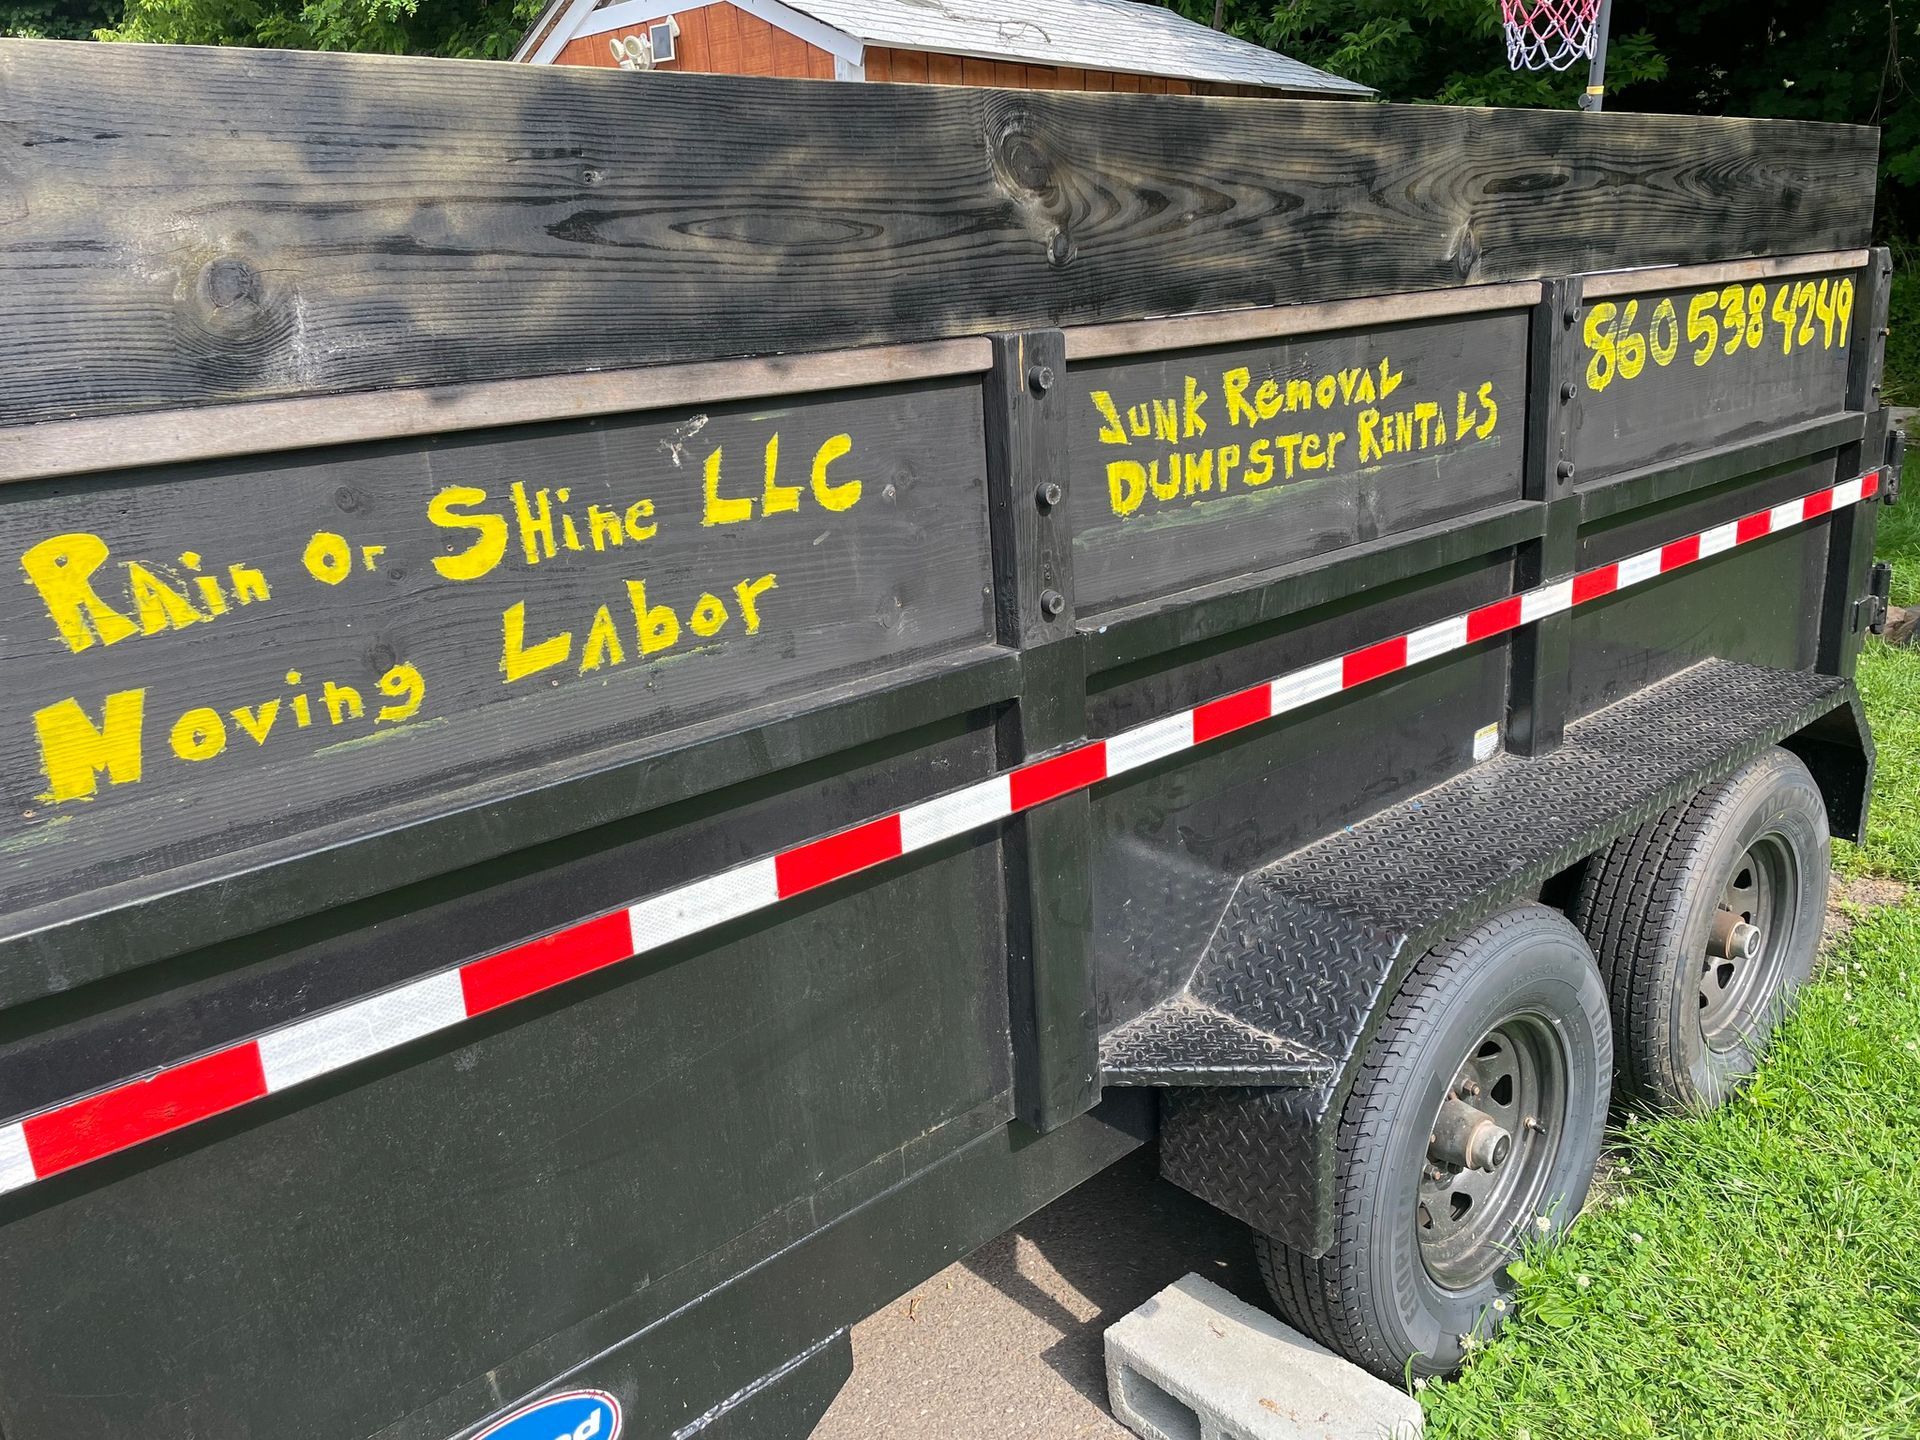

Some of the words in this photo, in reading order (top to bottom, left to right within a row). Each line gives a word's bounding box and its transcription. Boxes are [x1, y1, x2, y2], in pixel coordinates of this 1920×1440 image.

[1583, 298, 1678, 391] 860
[1687, 283, 1766, 366] 538
[1771, 277, 1854, 356] 4249
[1358, 381, 1498, 463] RENTALS
[701, 431, 863, 527] LLC
[34, 663, 426, 804] Moving
